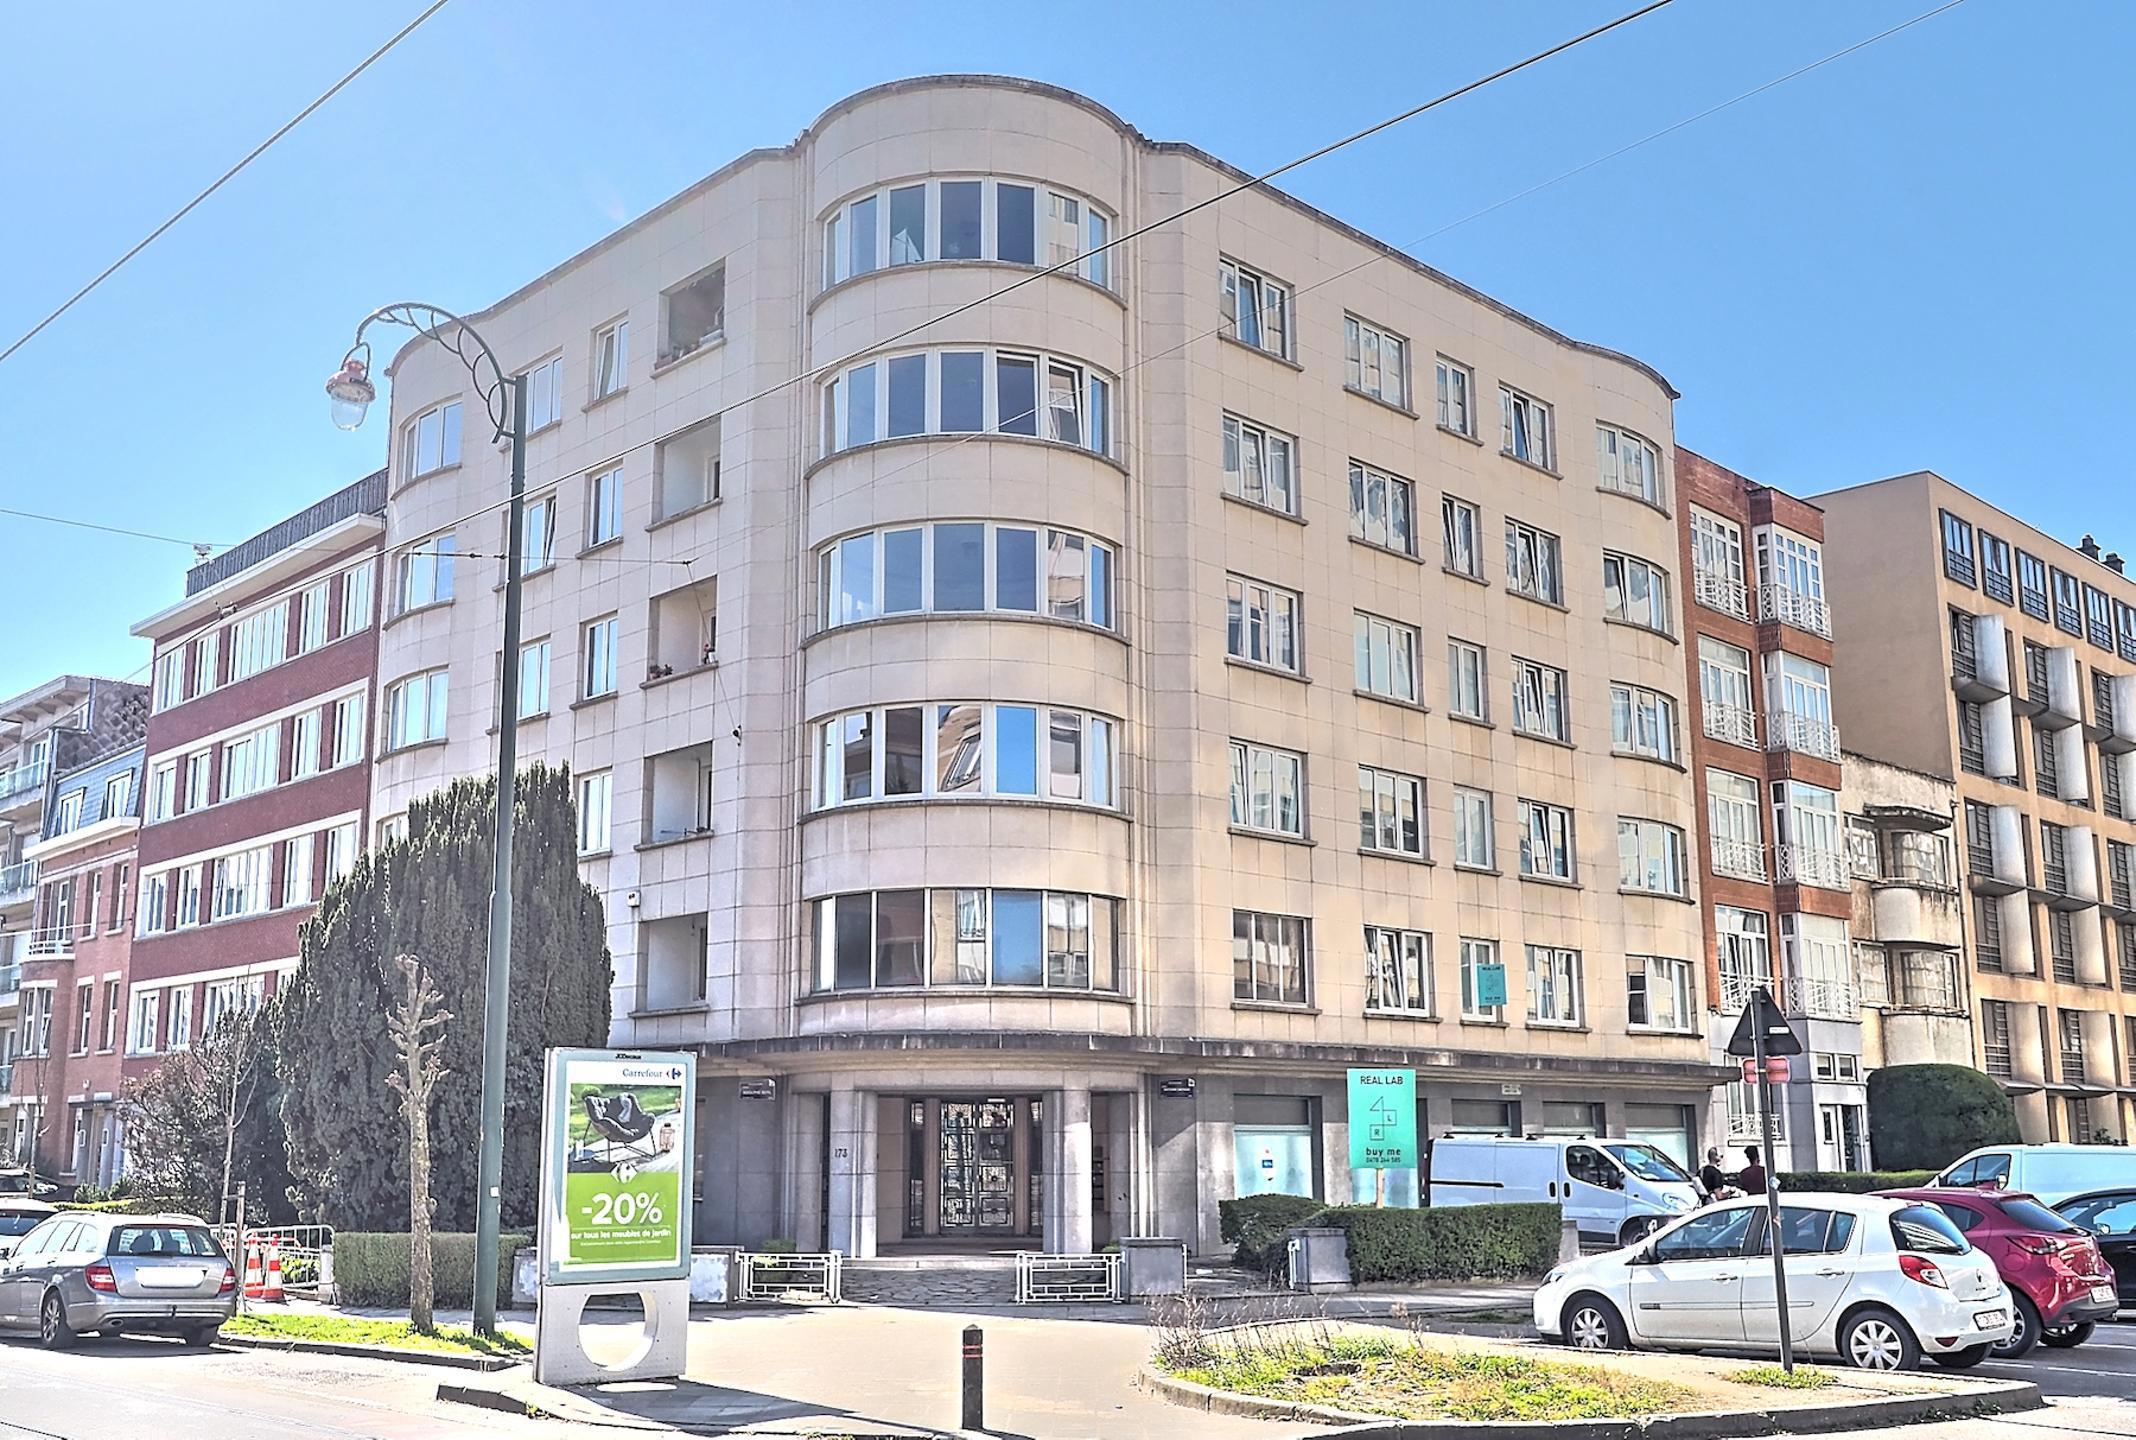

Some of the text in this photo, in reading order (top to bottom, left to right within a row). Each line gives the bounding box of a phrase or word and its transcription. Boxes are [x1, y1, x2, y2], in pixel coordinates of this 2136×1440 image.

[622, 1068, 663, 1078] Carrefour
[1360, 1076, 1404, 1085] REAL LAB
[834, 1148, 848, 1158] 173
[1366, 1147, 1401, 1156] buy me
[582, 1192, 662, 1225] -20%
[600, 1230, 611, 1238] les
[612, 1230, 640, 1238] meubles
[642, 1229, 651, 1237] de
[652, 1228, 671, 1238] jardin
